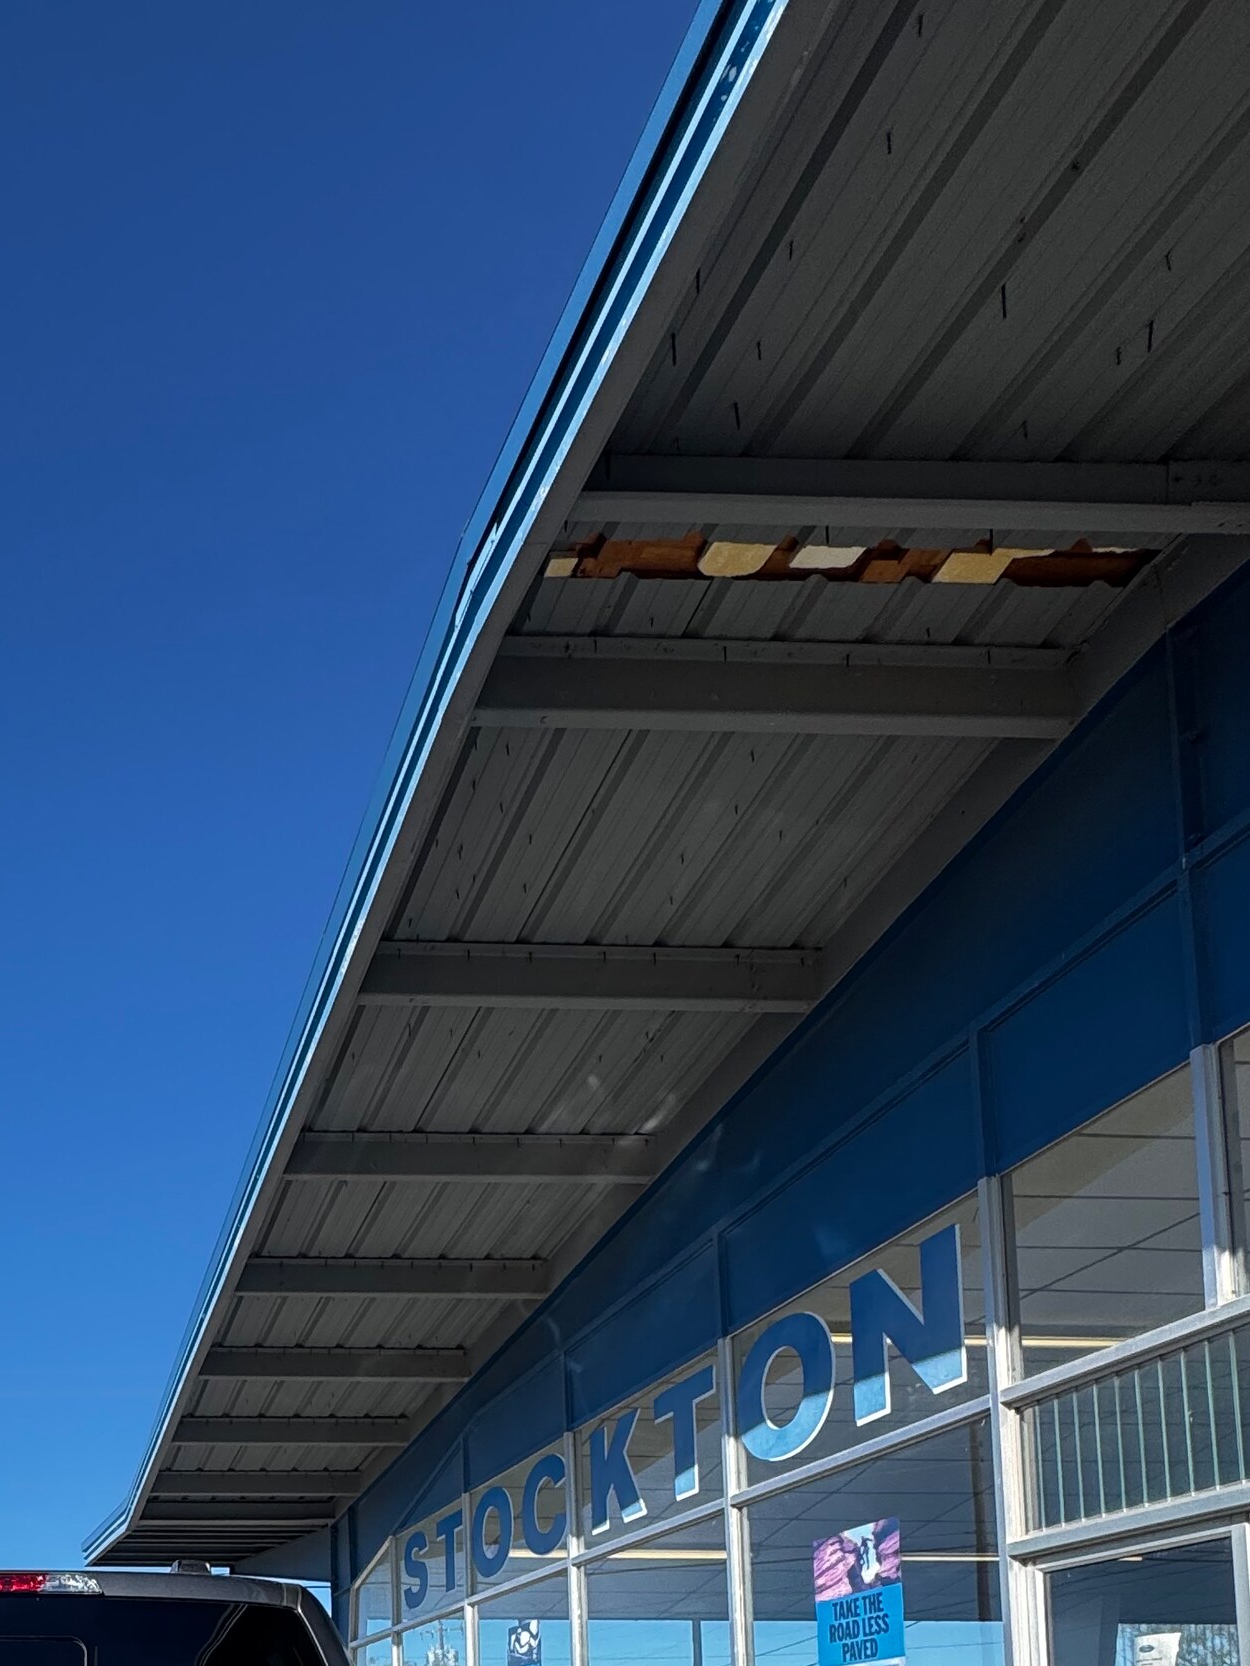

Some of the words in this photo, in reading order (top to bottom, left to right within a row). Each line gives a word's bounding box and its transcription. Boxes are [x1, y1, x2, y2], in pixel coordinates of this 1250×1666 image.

[403, 1224, 967, 1609] STOCKTON
[832, 1597, 860, 1621] TAKE
[862, 1591, 884, 1616] THE
[829, 1619, 860, 1643] ROAD
[862, 1613, 889, 1637] LESS
[842, 1638, 878, 1662] PAVED
